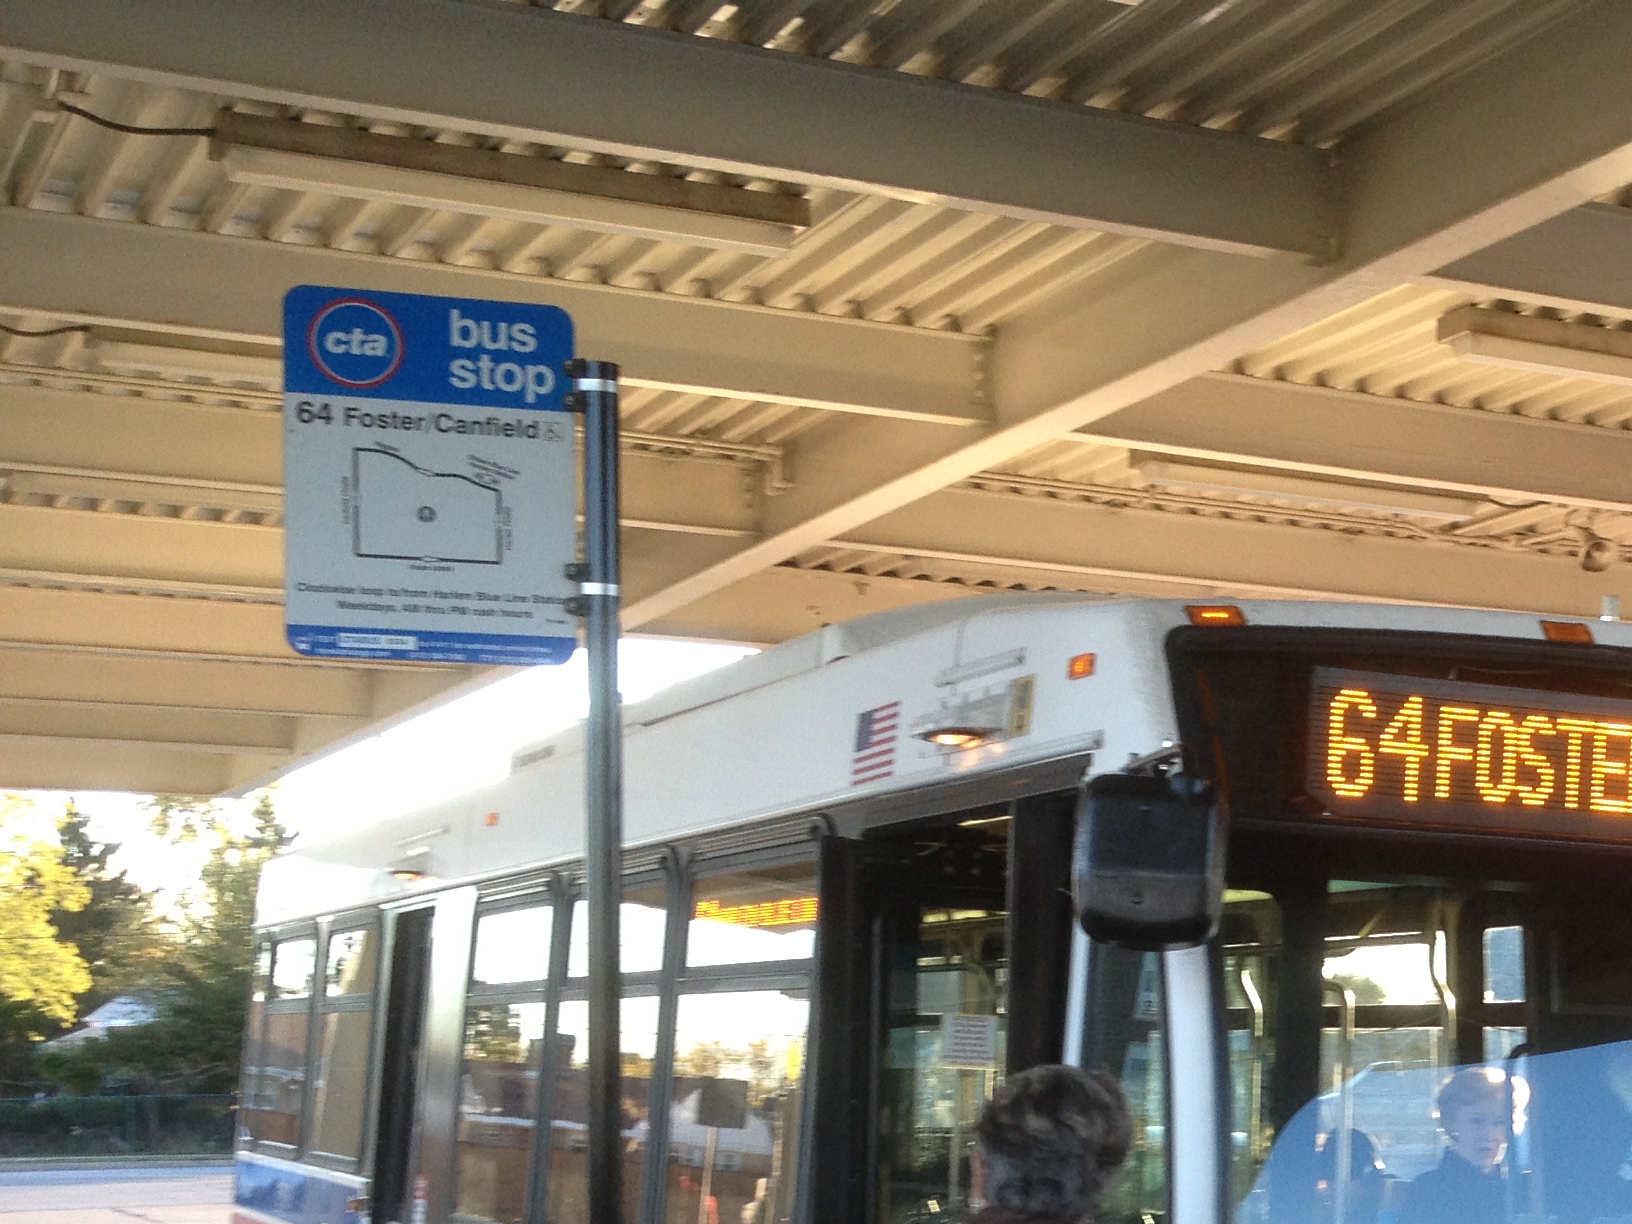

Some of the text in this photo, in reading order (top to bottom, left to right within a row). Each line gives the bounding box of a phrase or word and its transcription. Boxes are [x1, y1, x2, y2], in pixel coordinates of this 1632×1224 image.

[323, 327, 389, 358] cta
[449, 309, 538, 354] bus
[449, 354, 556, 404] stop
[297, 401, 540, 440] 64 Foster/Canfield
[1326, 689, 1429, 803] 64
